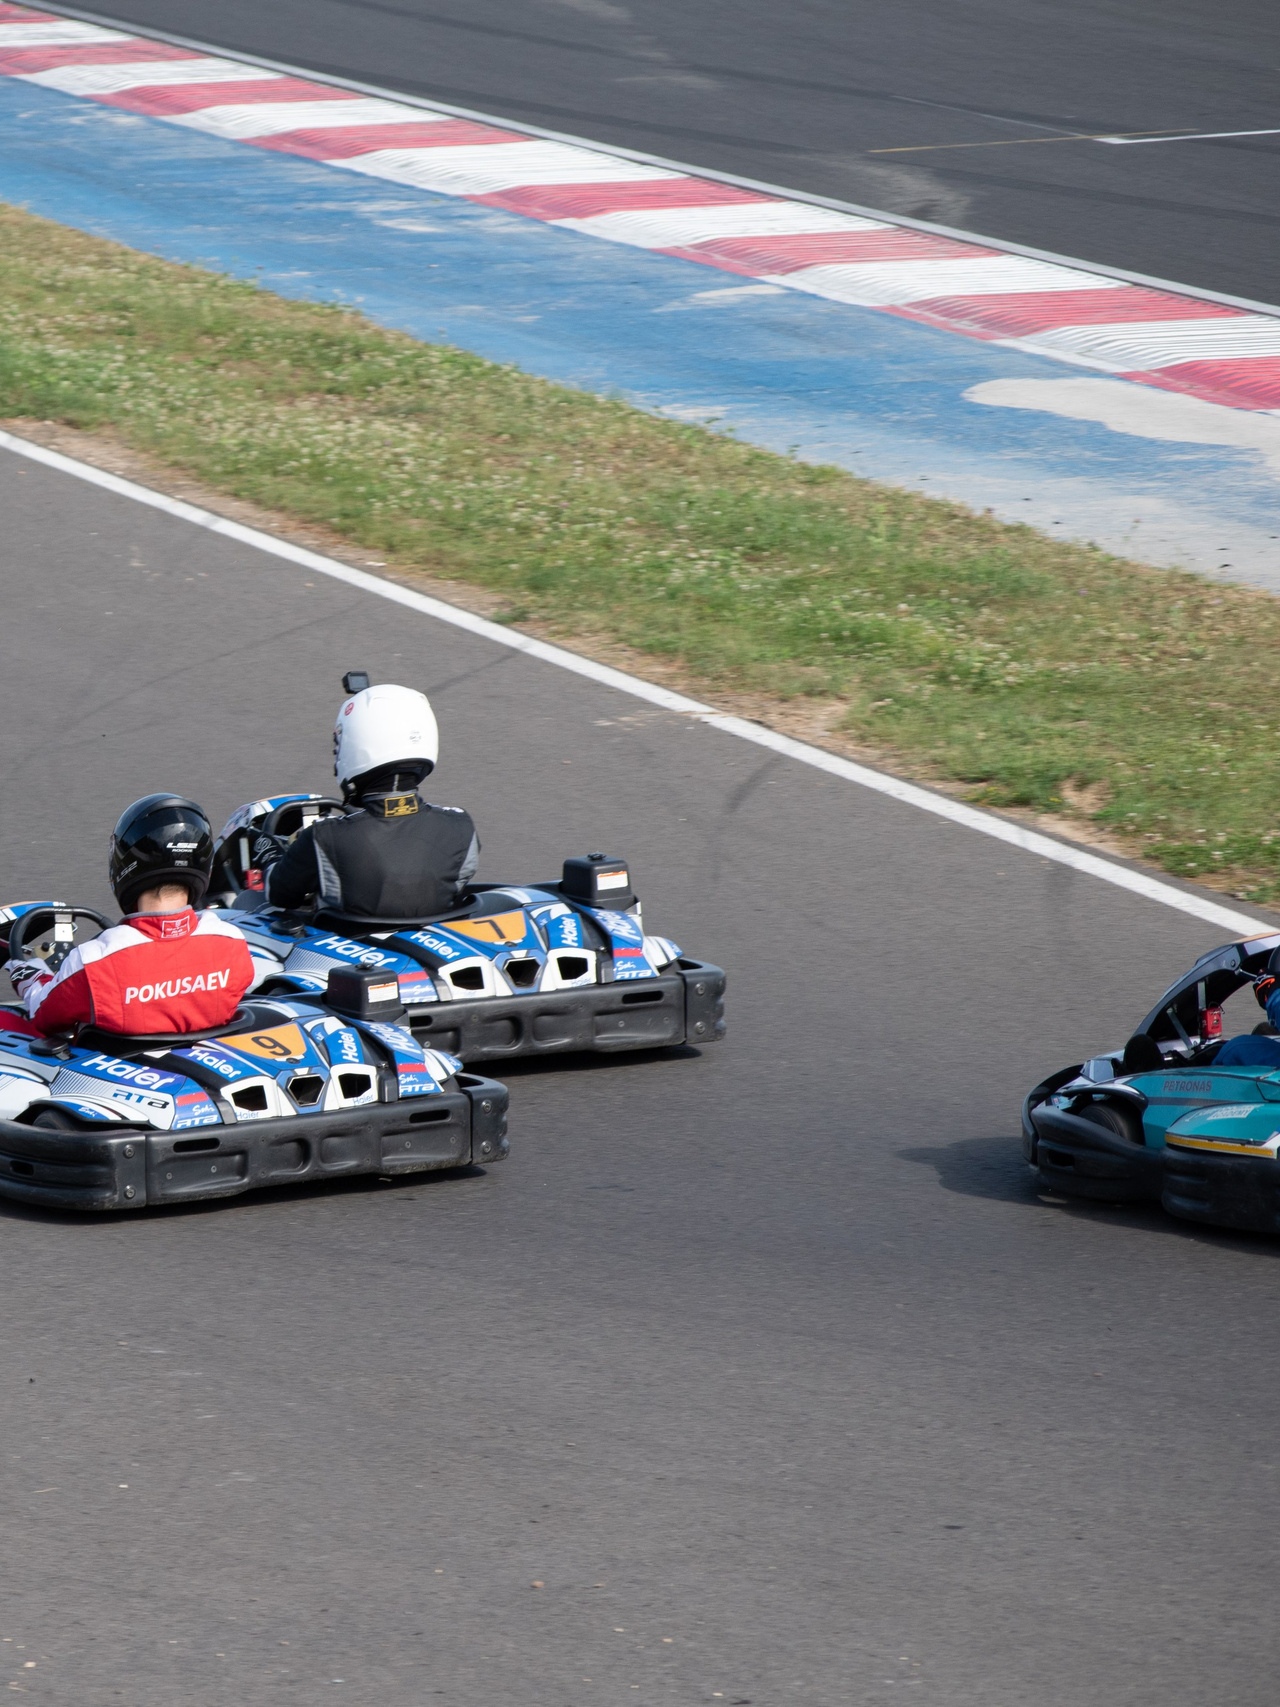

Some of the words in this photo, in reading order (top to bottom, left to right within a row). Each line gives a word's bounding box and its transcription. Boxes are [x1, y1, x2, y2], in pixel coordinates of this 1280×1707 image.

[473, 919, 507, 940] 7
[559, 916, 578, 947] Haier
[314, 935, 398, 967] Haier
[410, 932, 461, 959] Haier
[125, 968, 231, 1005] POKUSAEV
[251, 1035, 293, 1056] 9
[343, 1031, 360, 1063] Haier
[81, 1054, 177, 1090] Haier
[188, 1049, 242, 1079] Haier
[352, 1094, 374, 1106] Haier
[1162, 1080, 1212, 1092] PETRONAS
[236, 1111, 259, 1120] Haier
